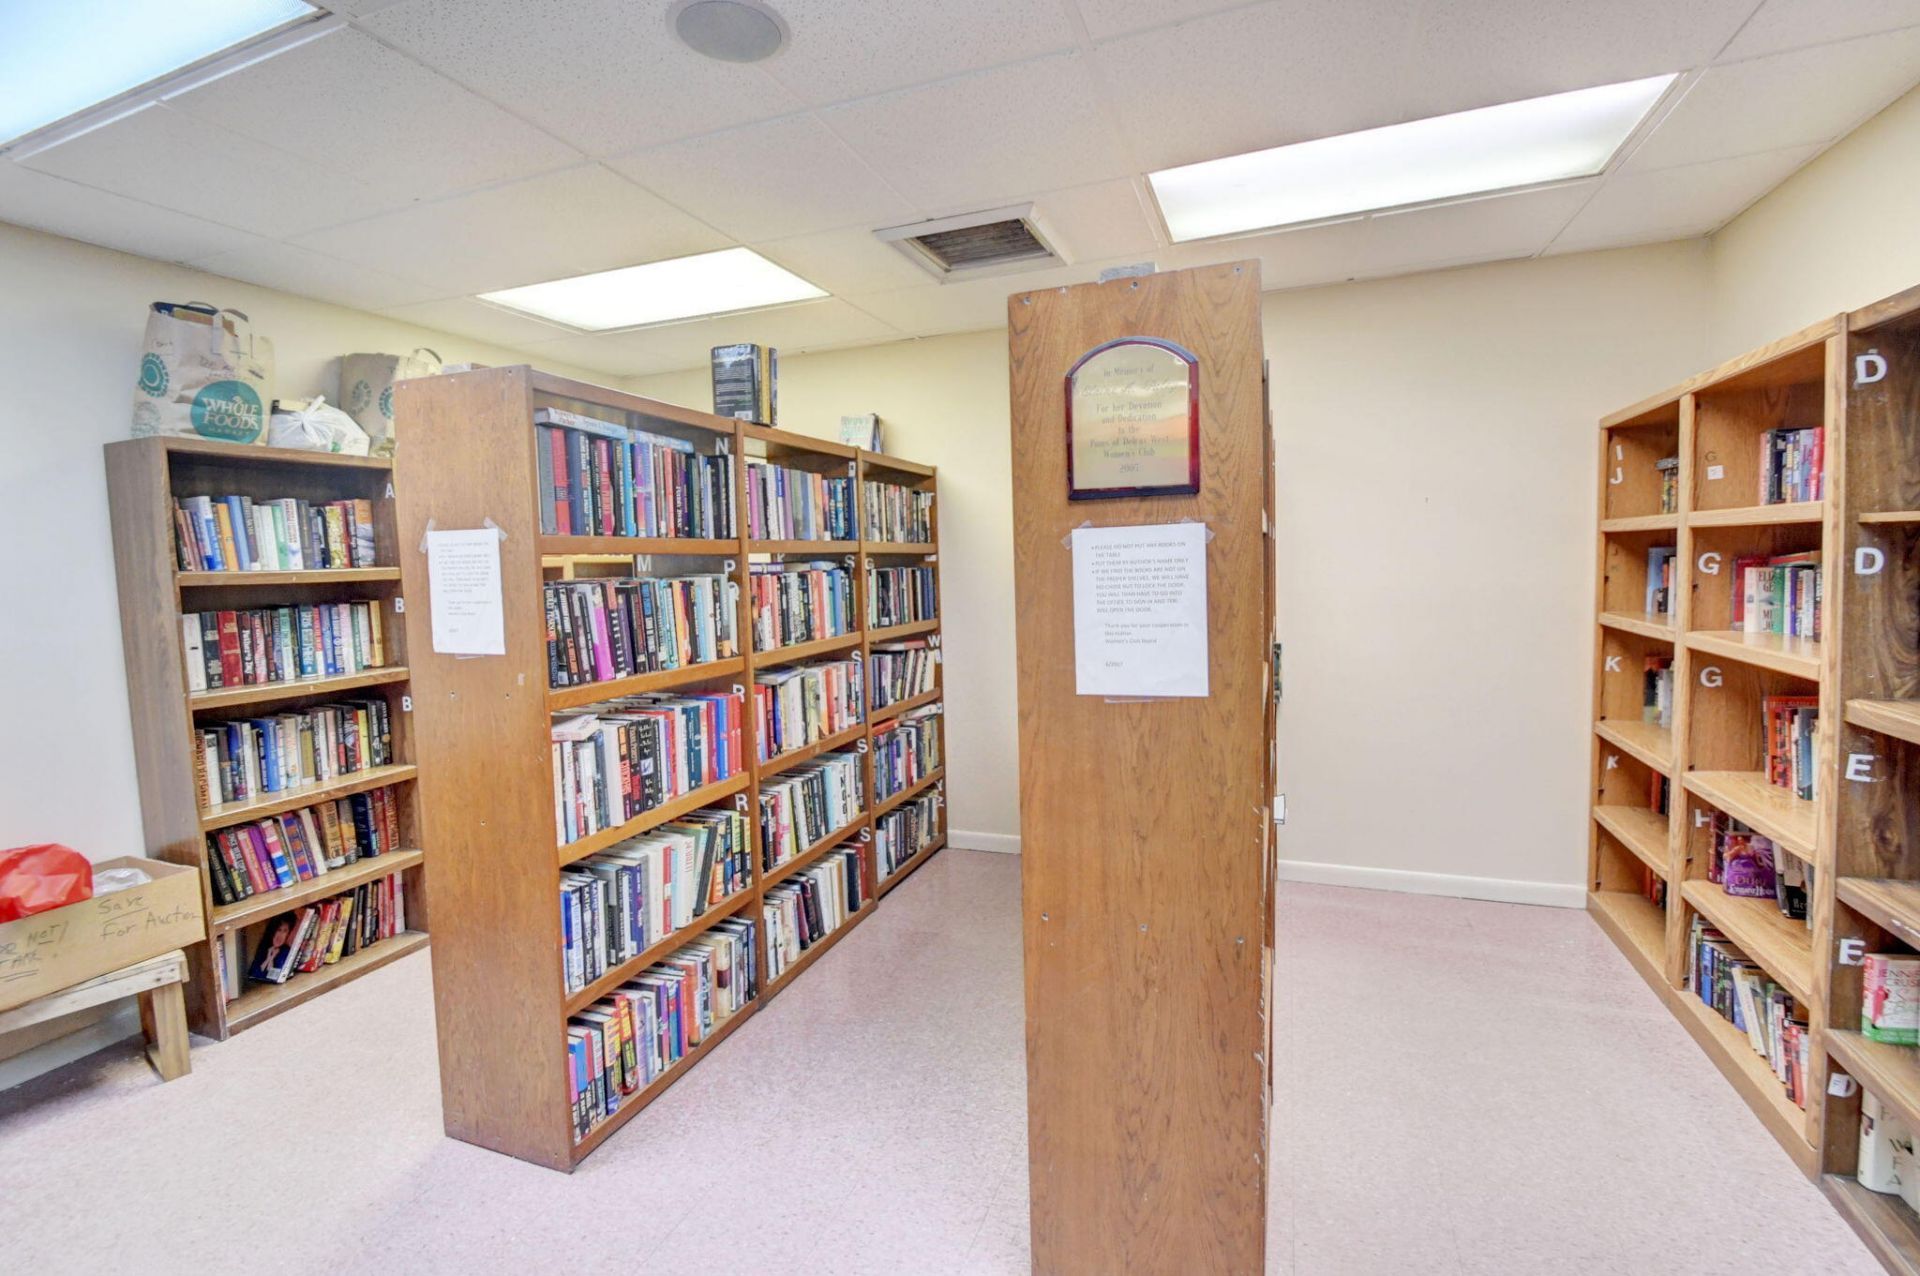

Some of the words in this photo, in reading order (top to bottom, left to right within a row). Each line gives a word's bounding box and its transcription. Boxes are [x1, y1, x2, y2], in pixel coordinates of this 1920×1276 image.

[1855, 354, 1888, 384] D
[201, 397, 260, 416] WHOLE
[202, 413, 260, 430] FOODS
[715, 437, 729, 455] N
[1610, 467, 1623, 484] J
[384, 482, 395, 499] A
[636, 554, 652, 572] M
[723, 559, 736, 577] P
[1697, 552, 1721, 575] G
[1854, 547, 1885, 575] D
[394, 597, 405, 613] B
[927, 634, 941, 648] W
[851, 650, 862, 663] S
[1605, 655, 1622, 673] K
[1700, 667, 1723, 687] G
[402, 695, 413, 711] B
[856, 738, 868, 754] S
[1606, 754, 1620, 771] K
[1845, 753, 1874, 782] E
[935, 779, 943, 791] Y
[735, 793, 748, 811] R
[859, 827, 871, 842] S
[97, 896, 144, 915] Save
[1839, 938, 1866, 967] E
